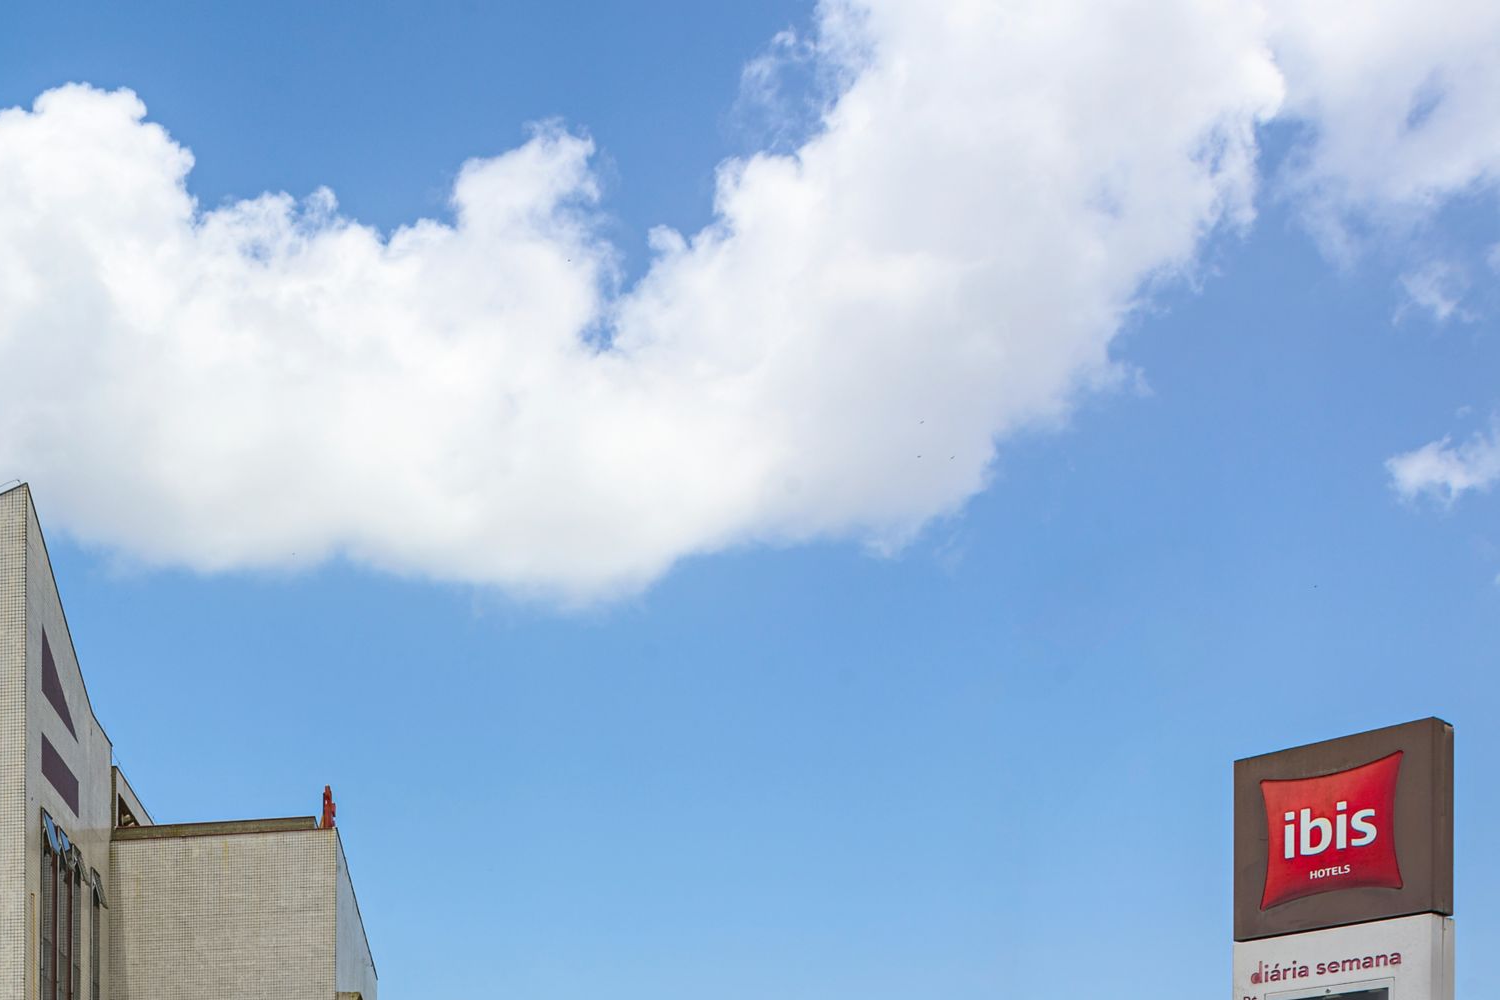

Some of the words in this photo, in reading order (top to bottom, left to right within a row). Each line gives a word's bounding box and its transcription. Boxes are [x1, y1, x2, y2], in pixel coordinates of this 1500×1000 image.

[1284, 801, 1377, 859] ibis
[1309, 864, 1350, 879] HOTELS
[1251, 961, 1309, 985] diária
[1316, 952, 1402, 975] semana
